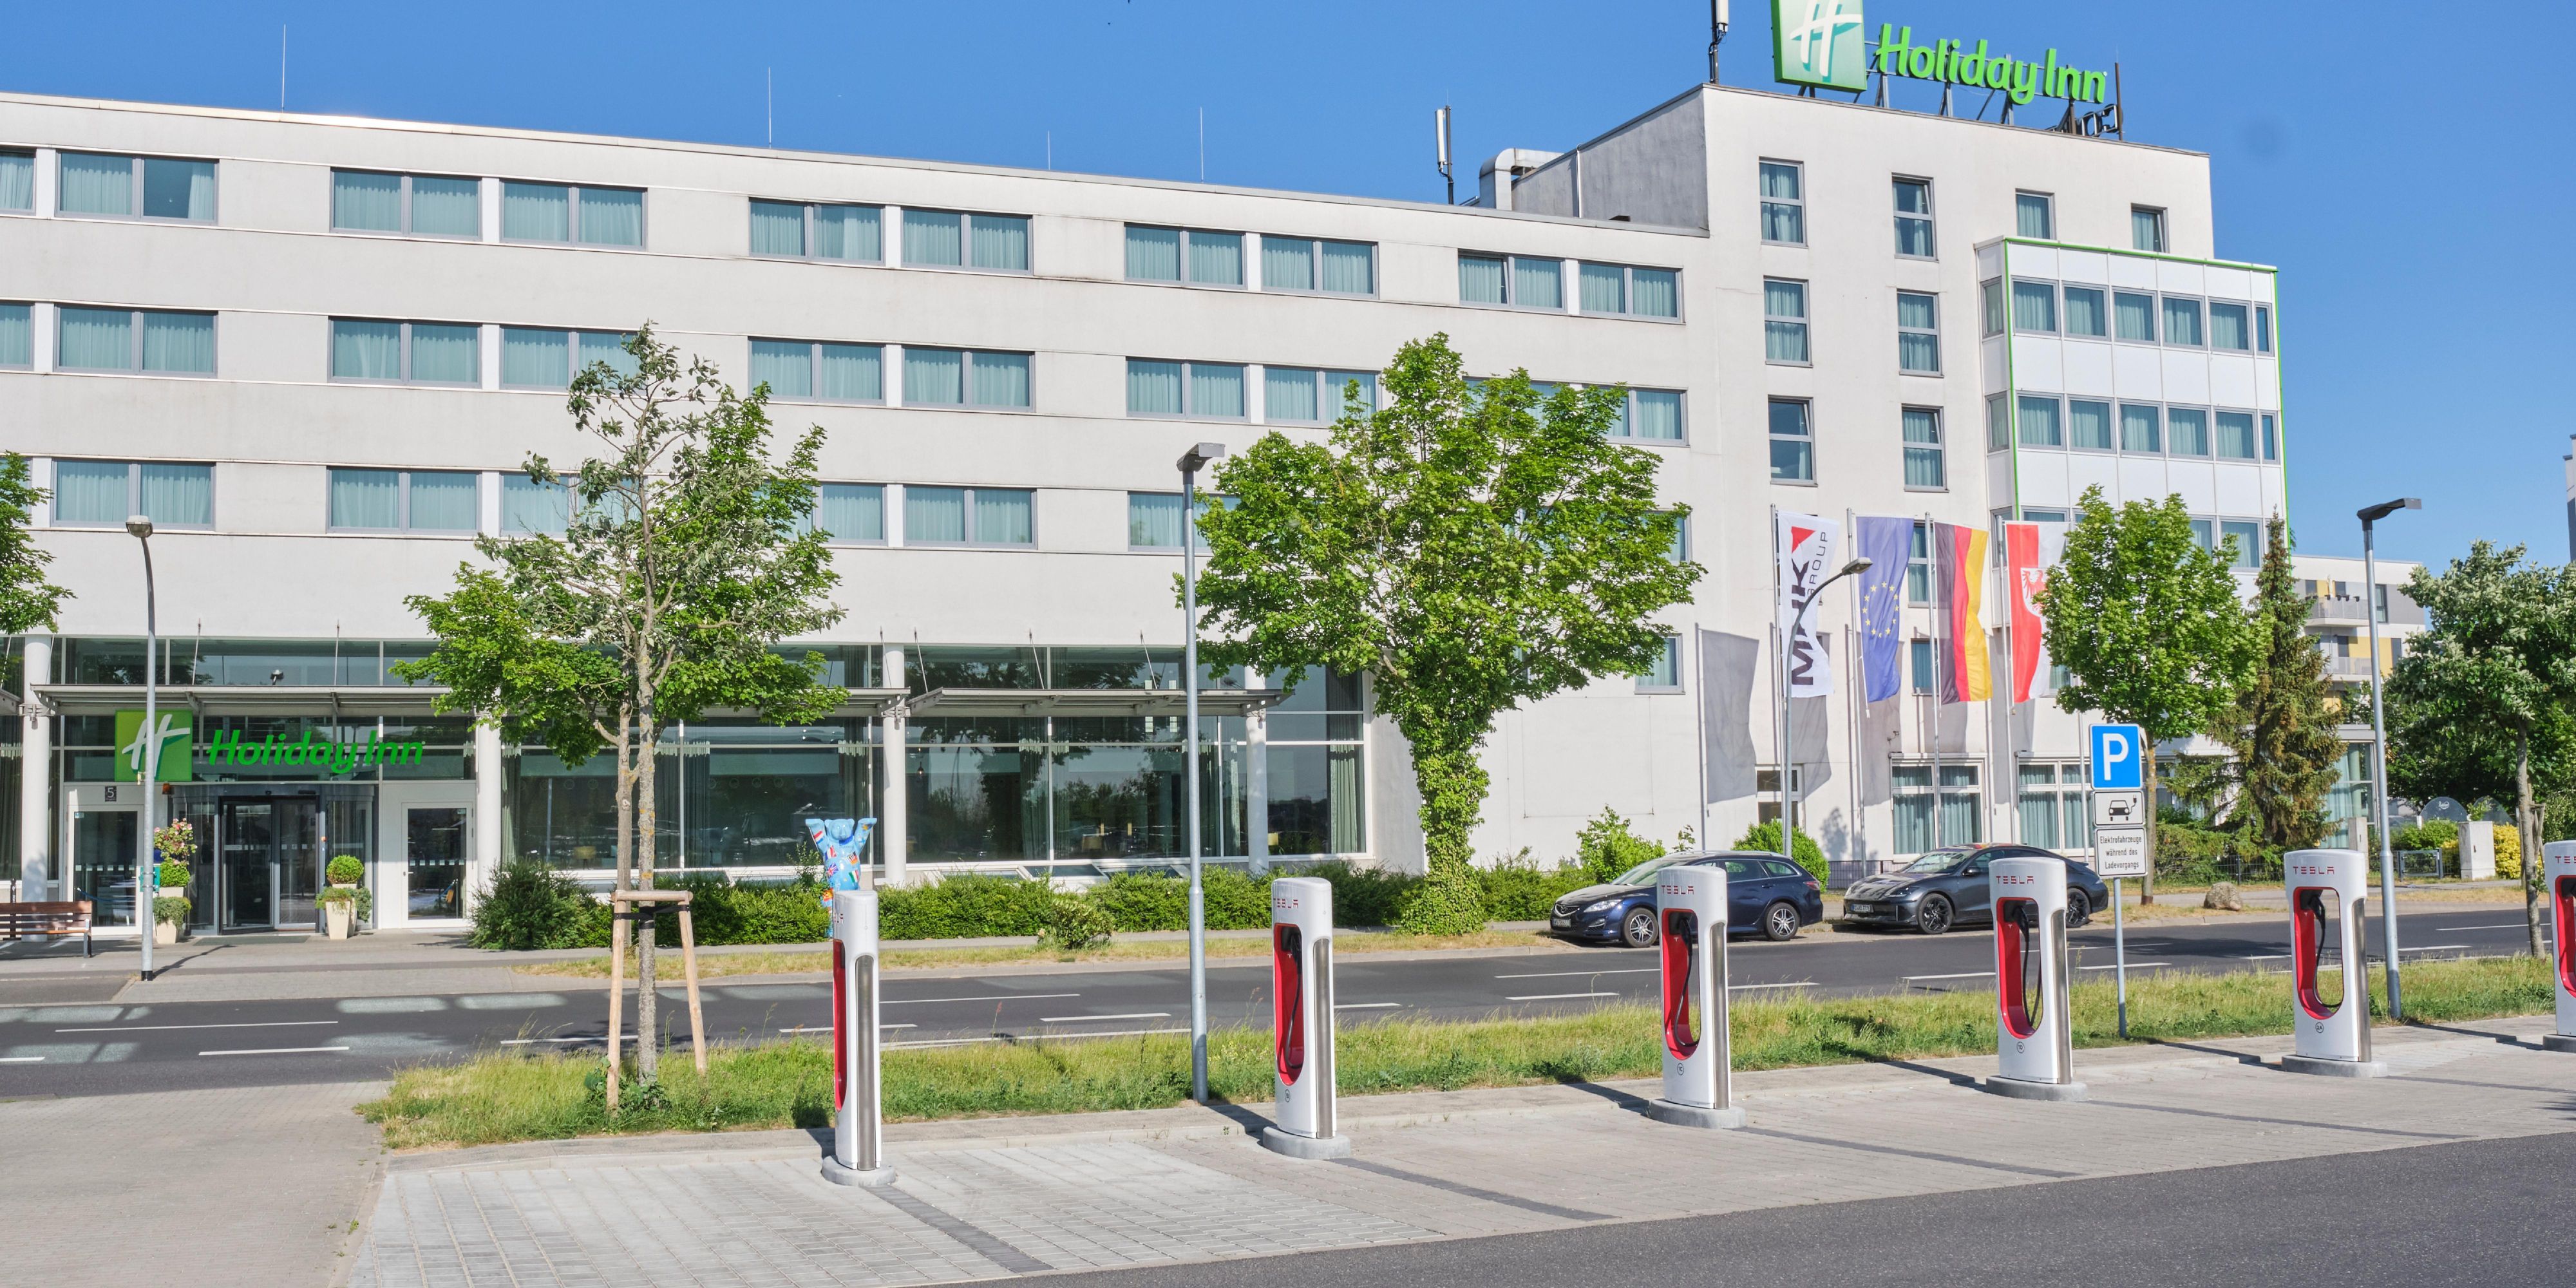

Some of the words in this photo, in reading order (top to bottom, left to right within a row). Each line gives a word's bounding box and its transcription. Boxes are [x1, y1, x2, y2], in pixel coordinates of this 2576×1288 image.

[1873, 23, 2038, 105] Holiday
[2043, 48, 2107, 104] Inn
[206, 729, 359, 774] Holiday
[364, 730, 425, 766] Inn
[2102, 733, 2129, 781] P
[108, 787, 115, 798] 5
[2100, 835, 2142, 844] Elektrofahrzeuge
[2105, 861, 2139, 870] Ladevorgangs
[2293, 866, 2334, 875] TESLA
[1996, 876, 2034, 884] TESLA
[1661, 885, 1694, 895] TESLA
